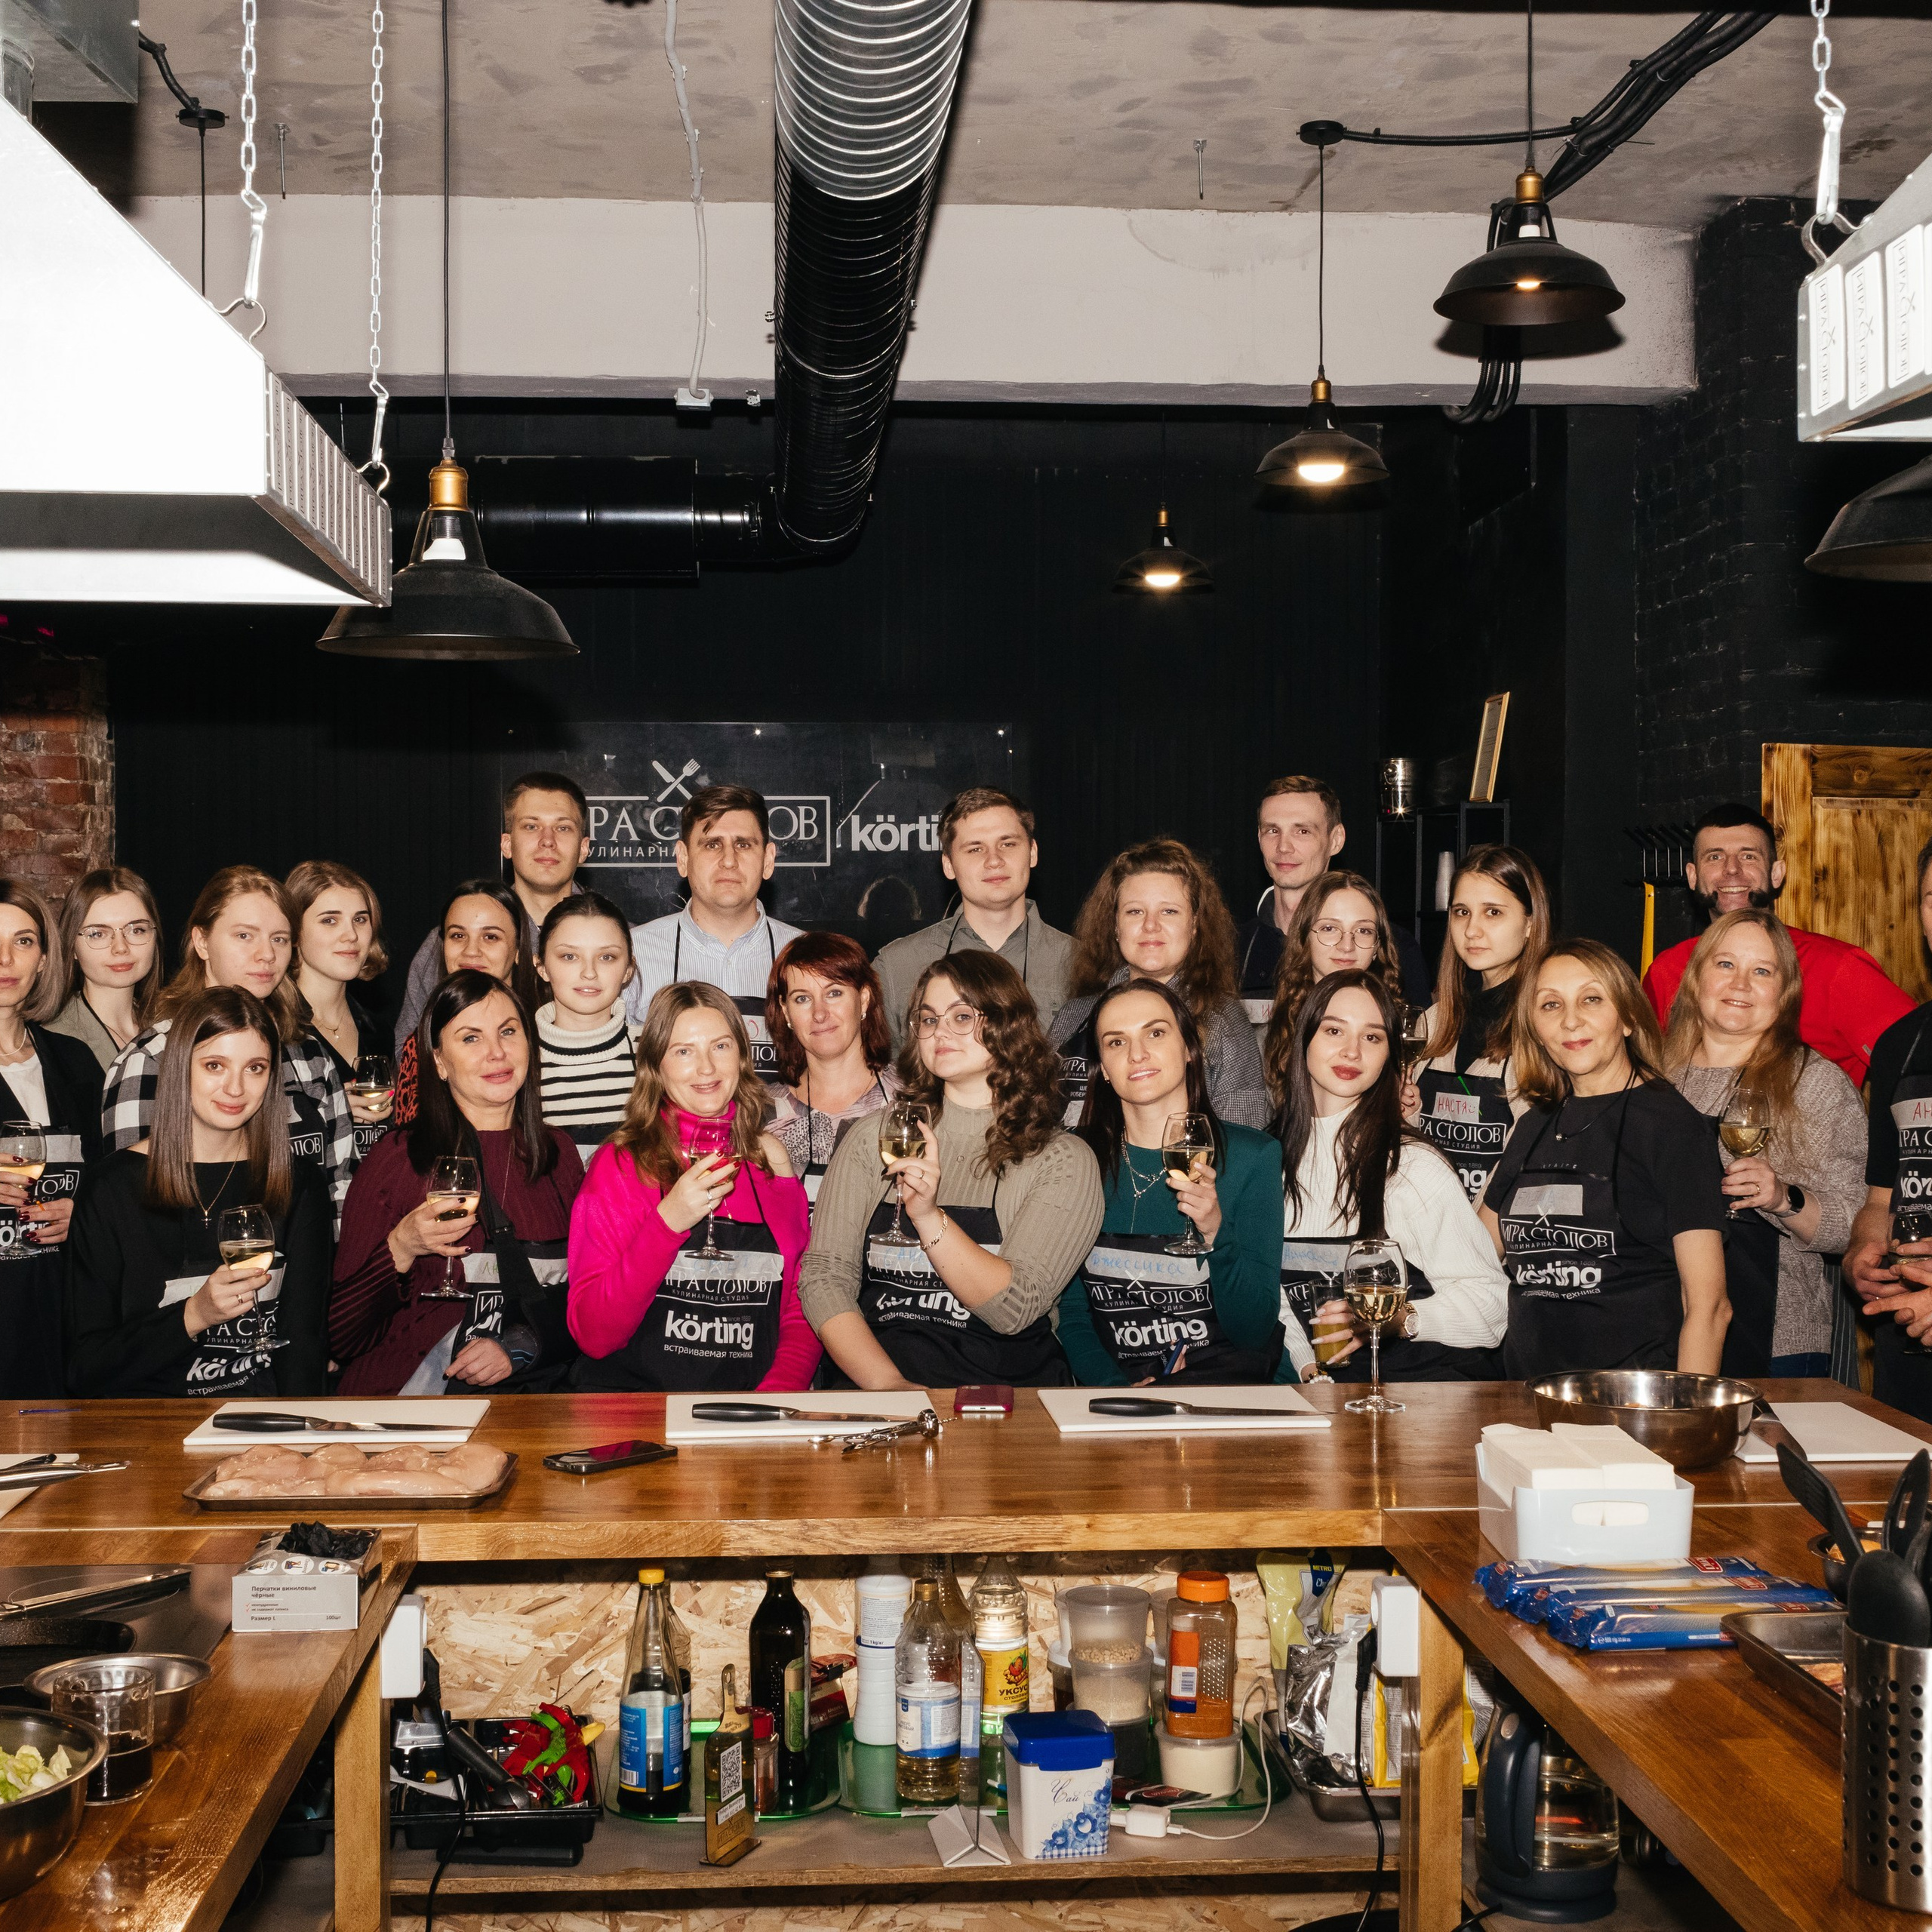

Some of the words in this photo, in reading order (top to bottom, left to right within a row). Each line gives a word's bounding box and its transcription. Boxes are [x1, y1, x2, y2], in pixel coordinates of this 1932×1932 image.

[587, 806, 640, 841] РА
[851, 815, 943, 852] körti
[588, 846, 678, 858] УЛИНАРН
[1437, 1097, 1468, 1115] НАСТЯ
[1419, 1118, 1432, 1136] РА
[1436, 1122, 1501, 1143] СТОЛОВ
[1899, 1130, 1920, 1148] ГРА
[289, 1137, 321, 1156] ЛОВ
[1502, 1223, 1531, 1242] ИГРА
[1531, 1227, 1608, 1249] СТОЛОВ
[1516, 1260, 1602, 1289] körting
[705, 1275, 768, 1295] СТОЛОВ
[1561, 1287, 1601, 1300] техника
[672, 1288, 718, 1301] КУЛИНАРНАЯ
[720, 1294, 749, 1303] СТУДИЯ
[1127, 1287, 1204, 1306] СТОЛОВ
[665, 1309, 754, 1350] körting
[933, 1316, 967, 1328] техника
[1109, 1318, 1208, 1351] körting
[663, 1343, 727, 1358] встраиваемая
[728, 1350, 753, 1358] техника
[187, 1375, 250, 1396] встраиваемая
[1051, 1778, 1081, 1807] Чай
